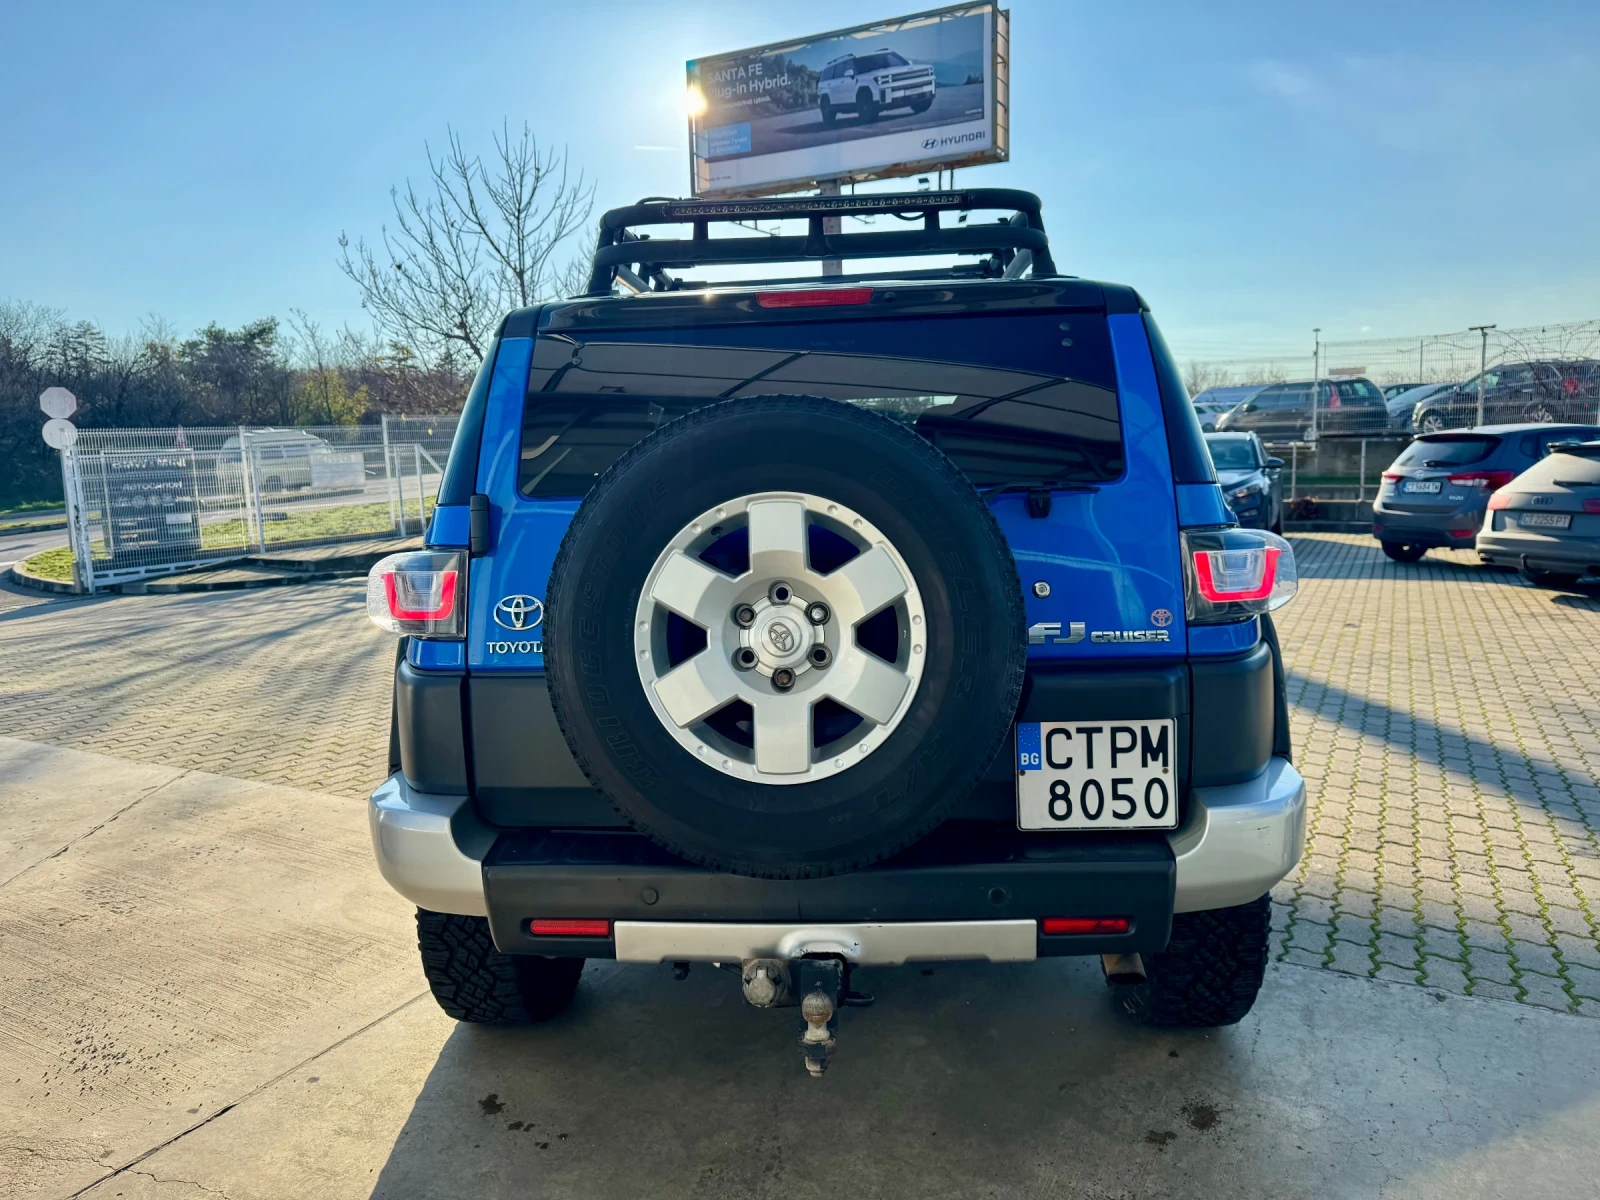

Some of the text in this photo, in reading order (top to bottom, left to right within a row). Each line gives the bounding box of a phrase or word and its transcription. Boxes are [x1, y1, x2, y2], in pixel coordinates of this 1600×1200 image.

[706, 63, 763, 84] SANTA FE
[707, 73, 792, 99] Plug-in Hybrid.
[940, 131, 985, 146] HYUNDAI
[869, 468, 982, 705] DUELER
[579, 476, 670, 788] BRIDGESTONE
[1028, 621, 1170, 644] FJ CRUISER
[486, 641, 543, 653] TOYOT
[1020, 752, 1040, 766] BG
[1045, 725, 1169, 769] CTPM
[1048, 777, 1169, 821] 8050
